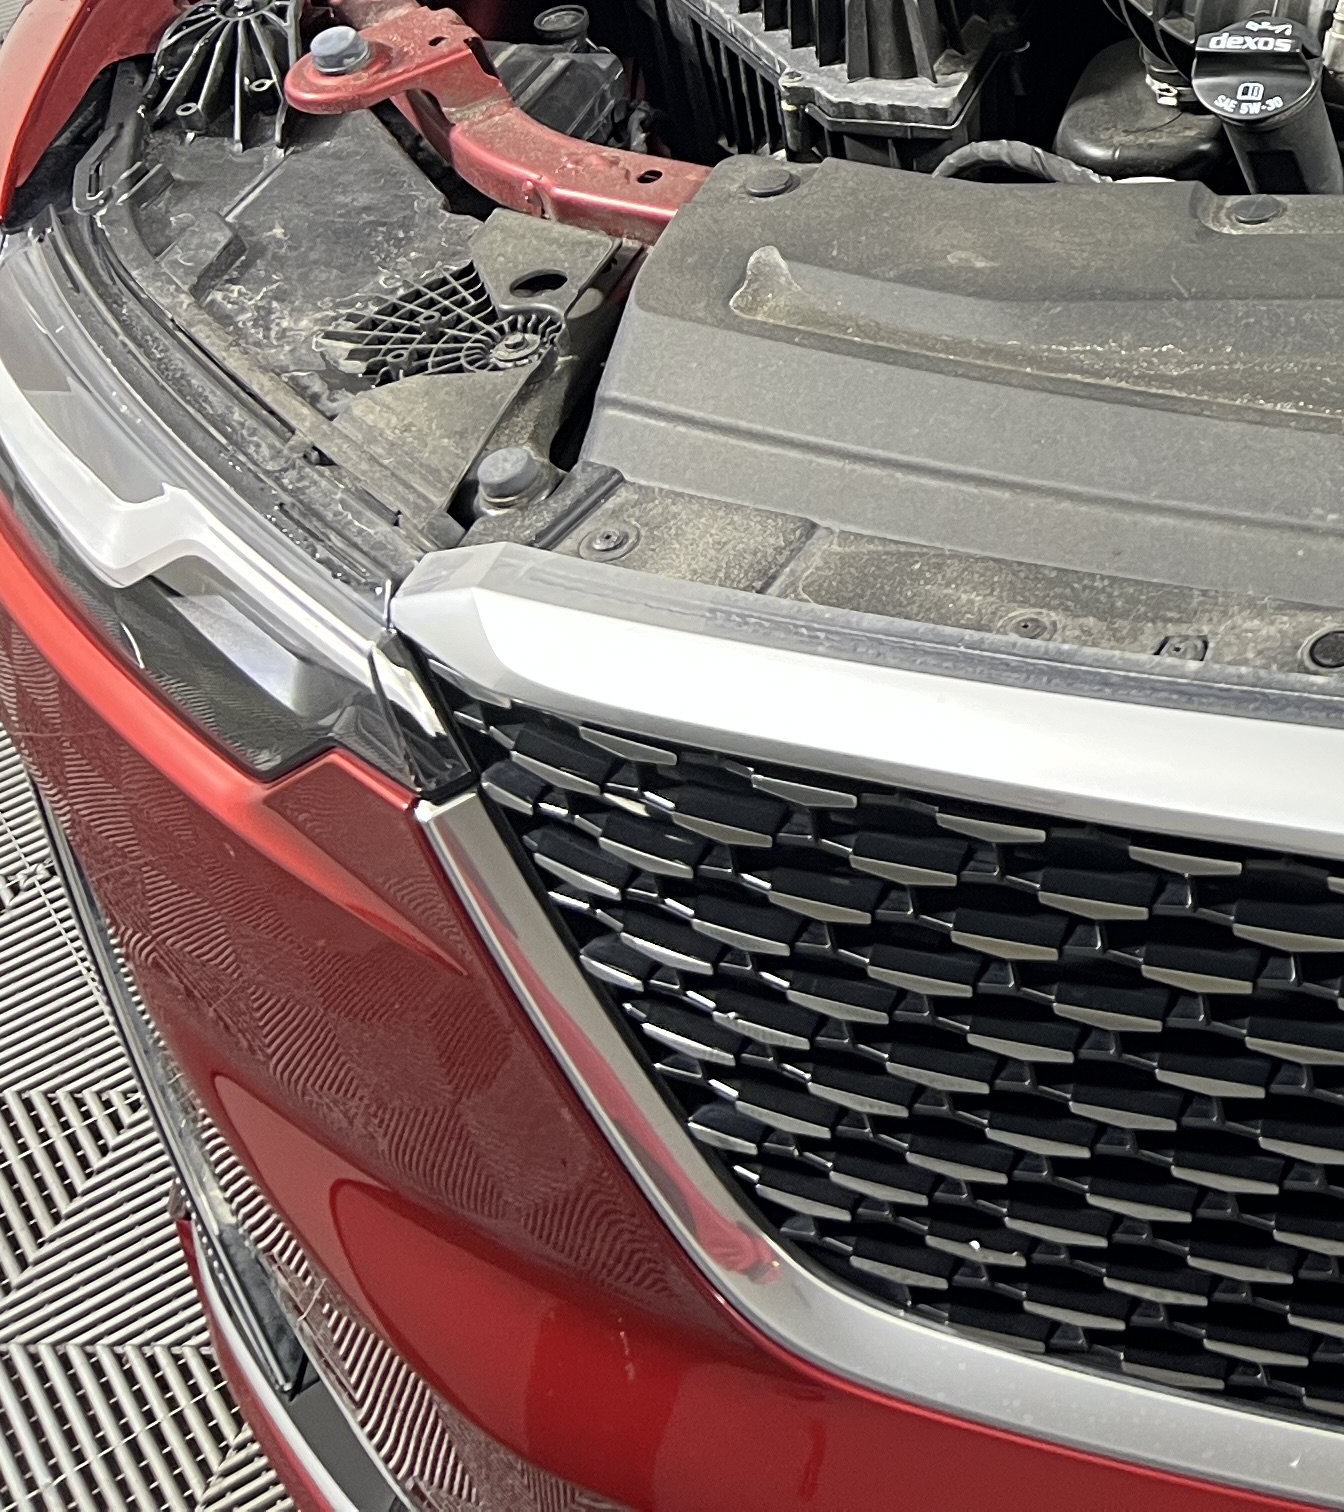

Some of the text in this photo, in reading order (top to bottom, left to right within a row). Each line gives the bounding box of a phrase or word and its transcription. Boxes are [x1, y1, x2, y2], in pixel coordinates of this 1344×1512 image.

[1208, 32, 1293, 52] dexos
[1214, 94, 1284, 115] SAE 5W-30
